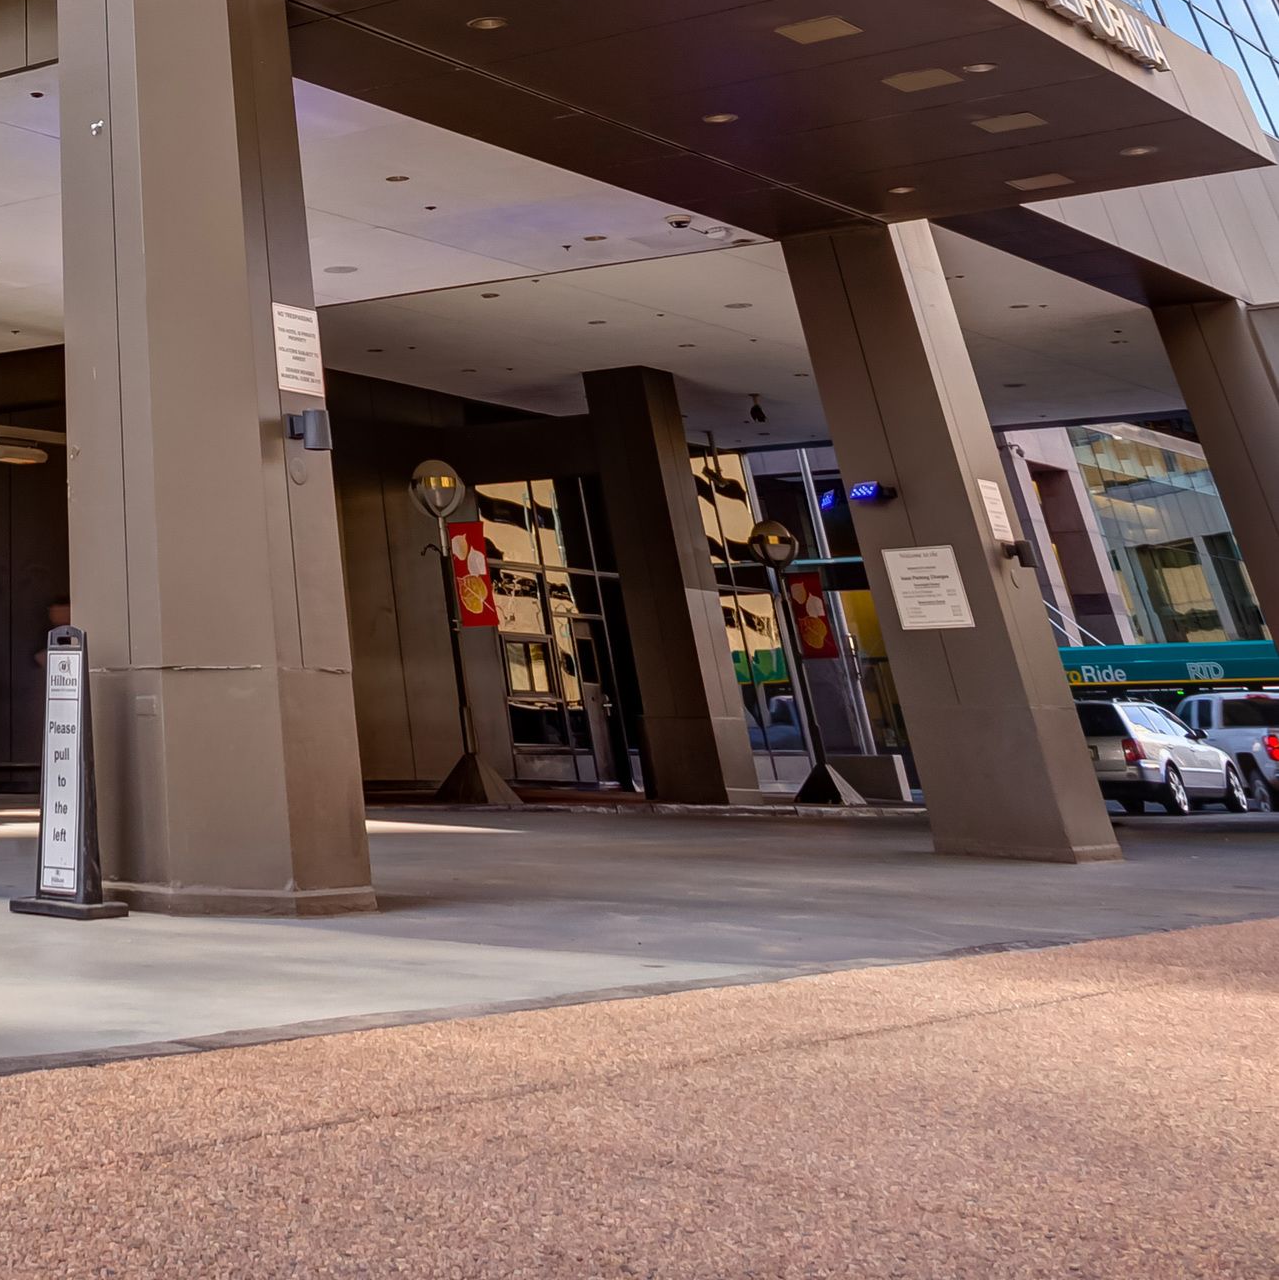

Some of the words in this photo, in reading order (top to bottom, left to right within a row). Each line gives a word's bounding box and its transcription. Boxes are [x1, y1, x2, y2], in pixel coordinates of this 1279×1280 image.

[1186, 661, 1225, 680] RTD
[50, 674, 77, 687] Hilton
[49, 721, 76, 734] Please
[54, 747, 70, 763] pull
[57, 774, 67, 788] to
[54, 801, 68, 814] the
[52, 827, 67, 842] left
